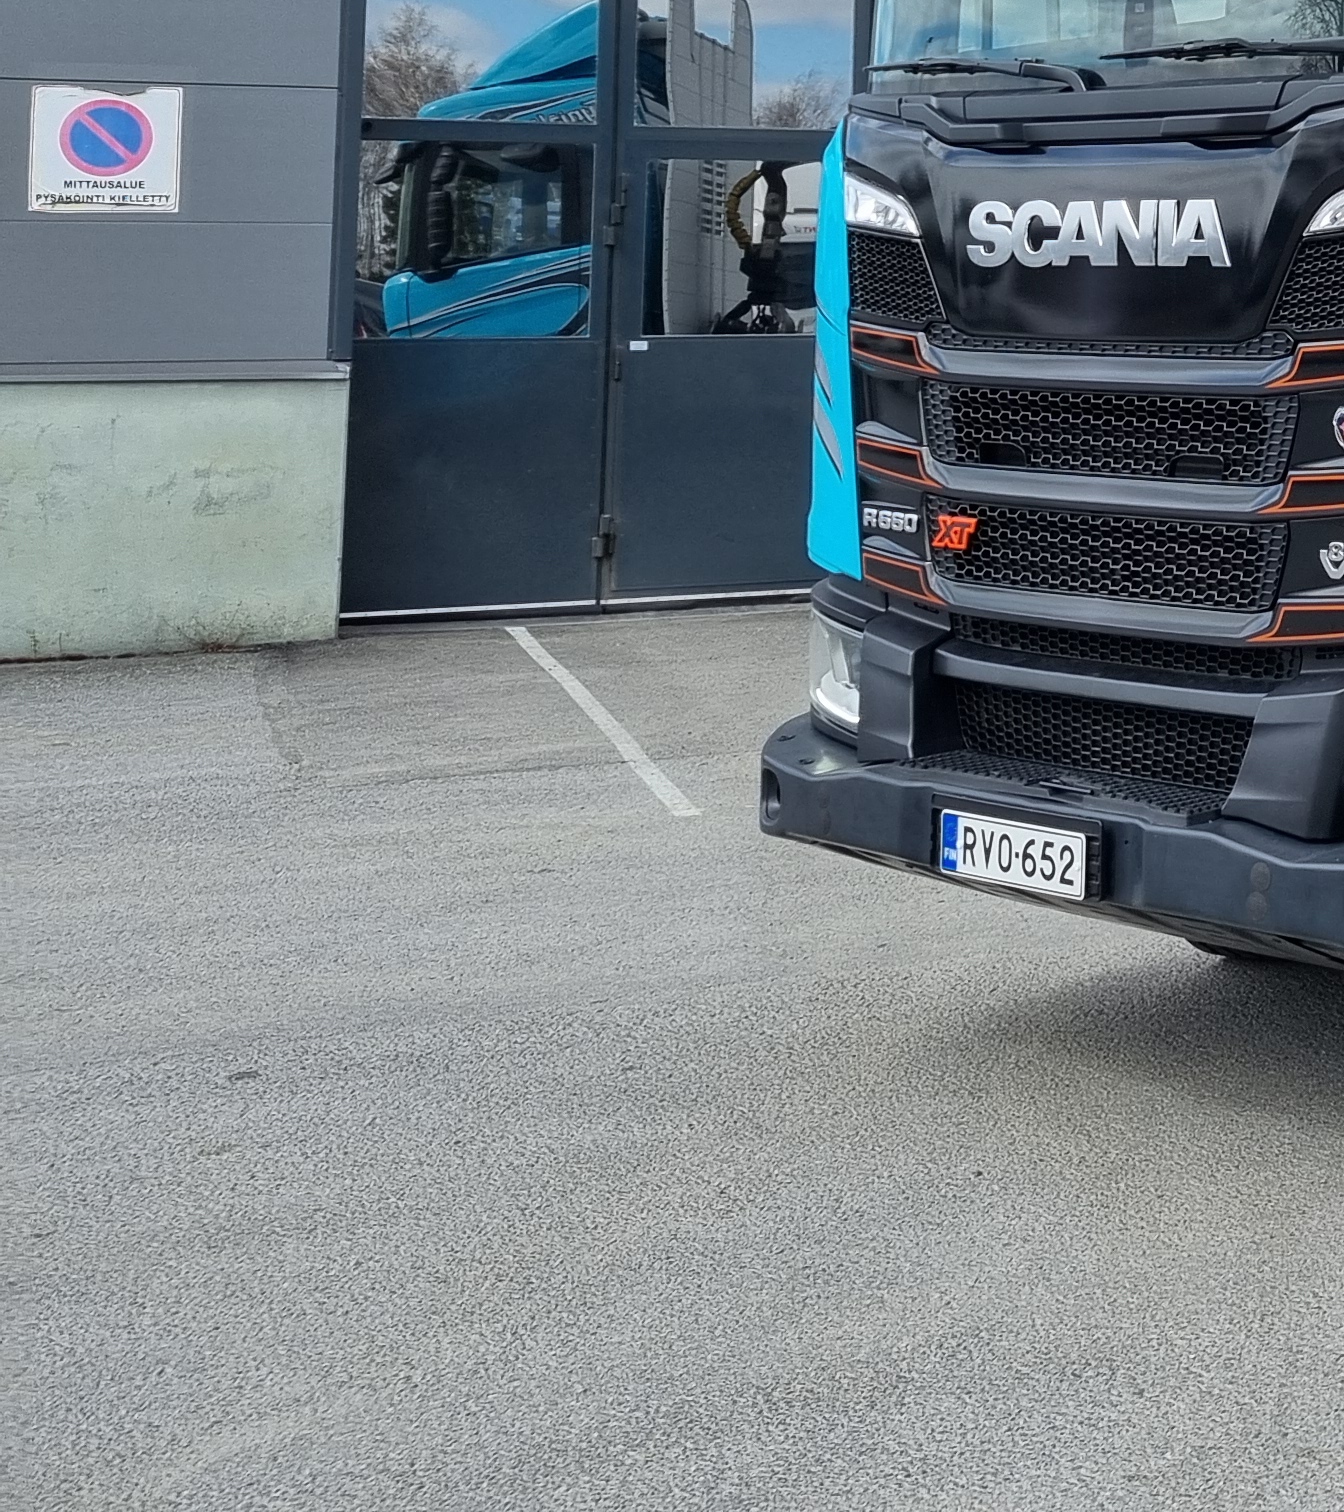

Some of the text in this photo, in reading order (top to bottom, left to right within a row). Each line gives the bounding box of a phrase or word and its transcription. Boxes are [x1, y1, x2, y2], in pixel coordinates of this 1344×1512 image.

[35, 192, 171, 204] PYSÄKÖINTI KIELLETTY
[63, 180, 146, 190] MITTAUSALUE
[966, 199, 1232, 268] SCANIA
[931, 514, 979, 550] XT
[944, 825, 1075, 887] FIN RVO-652
